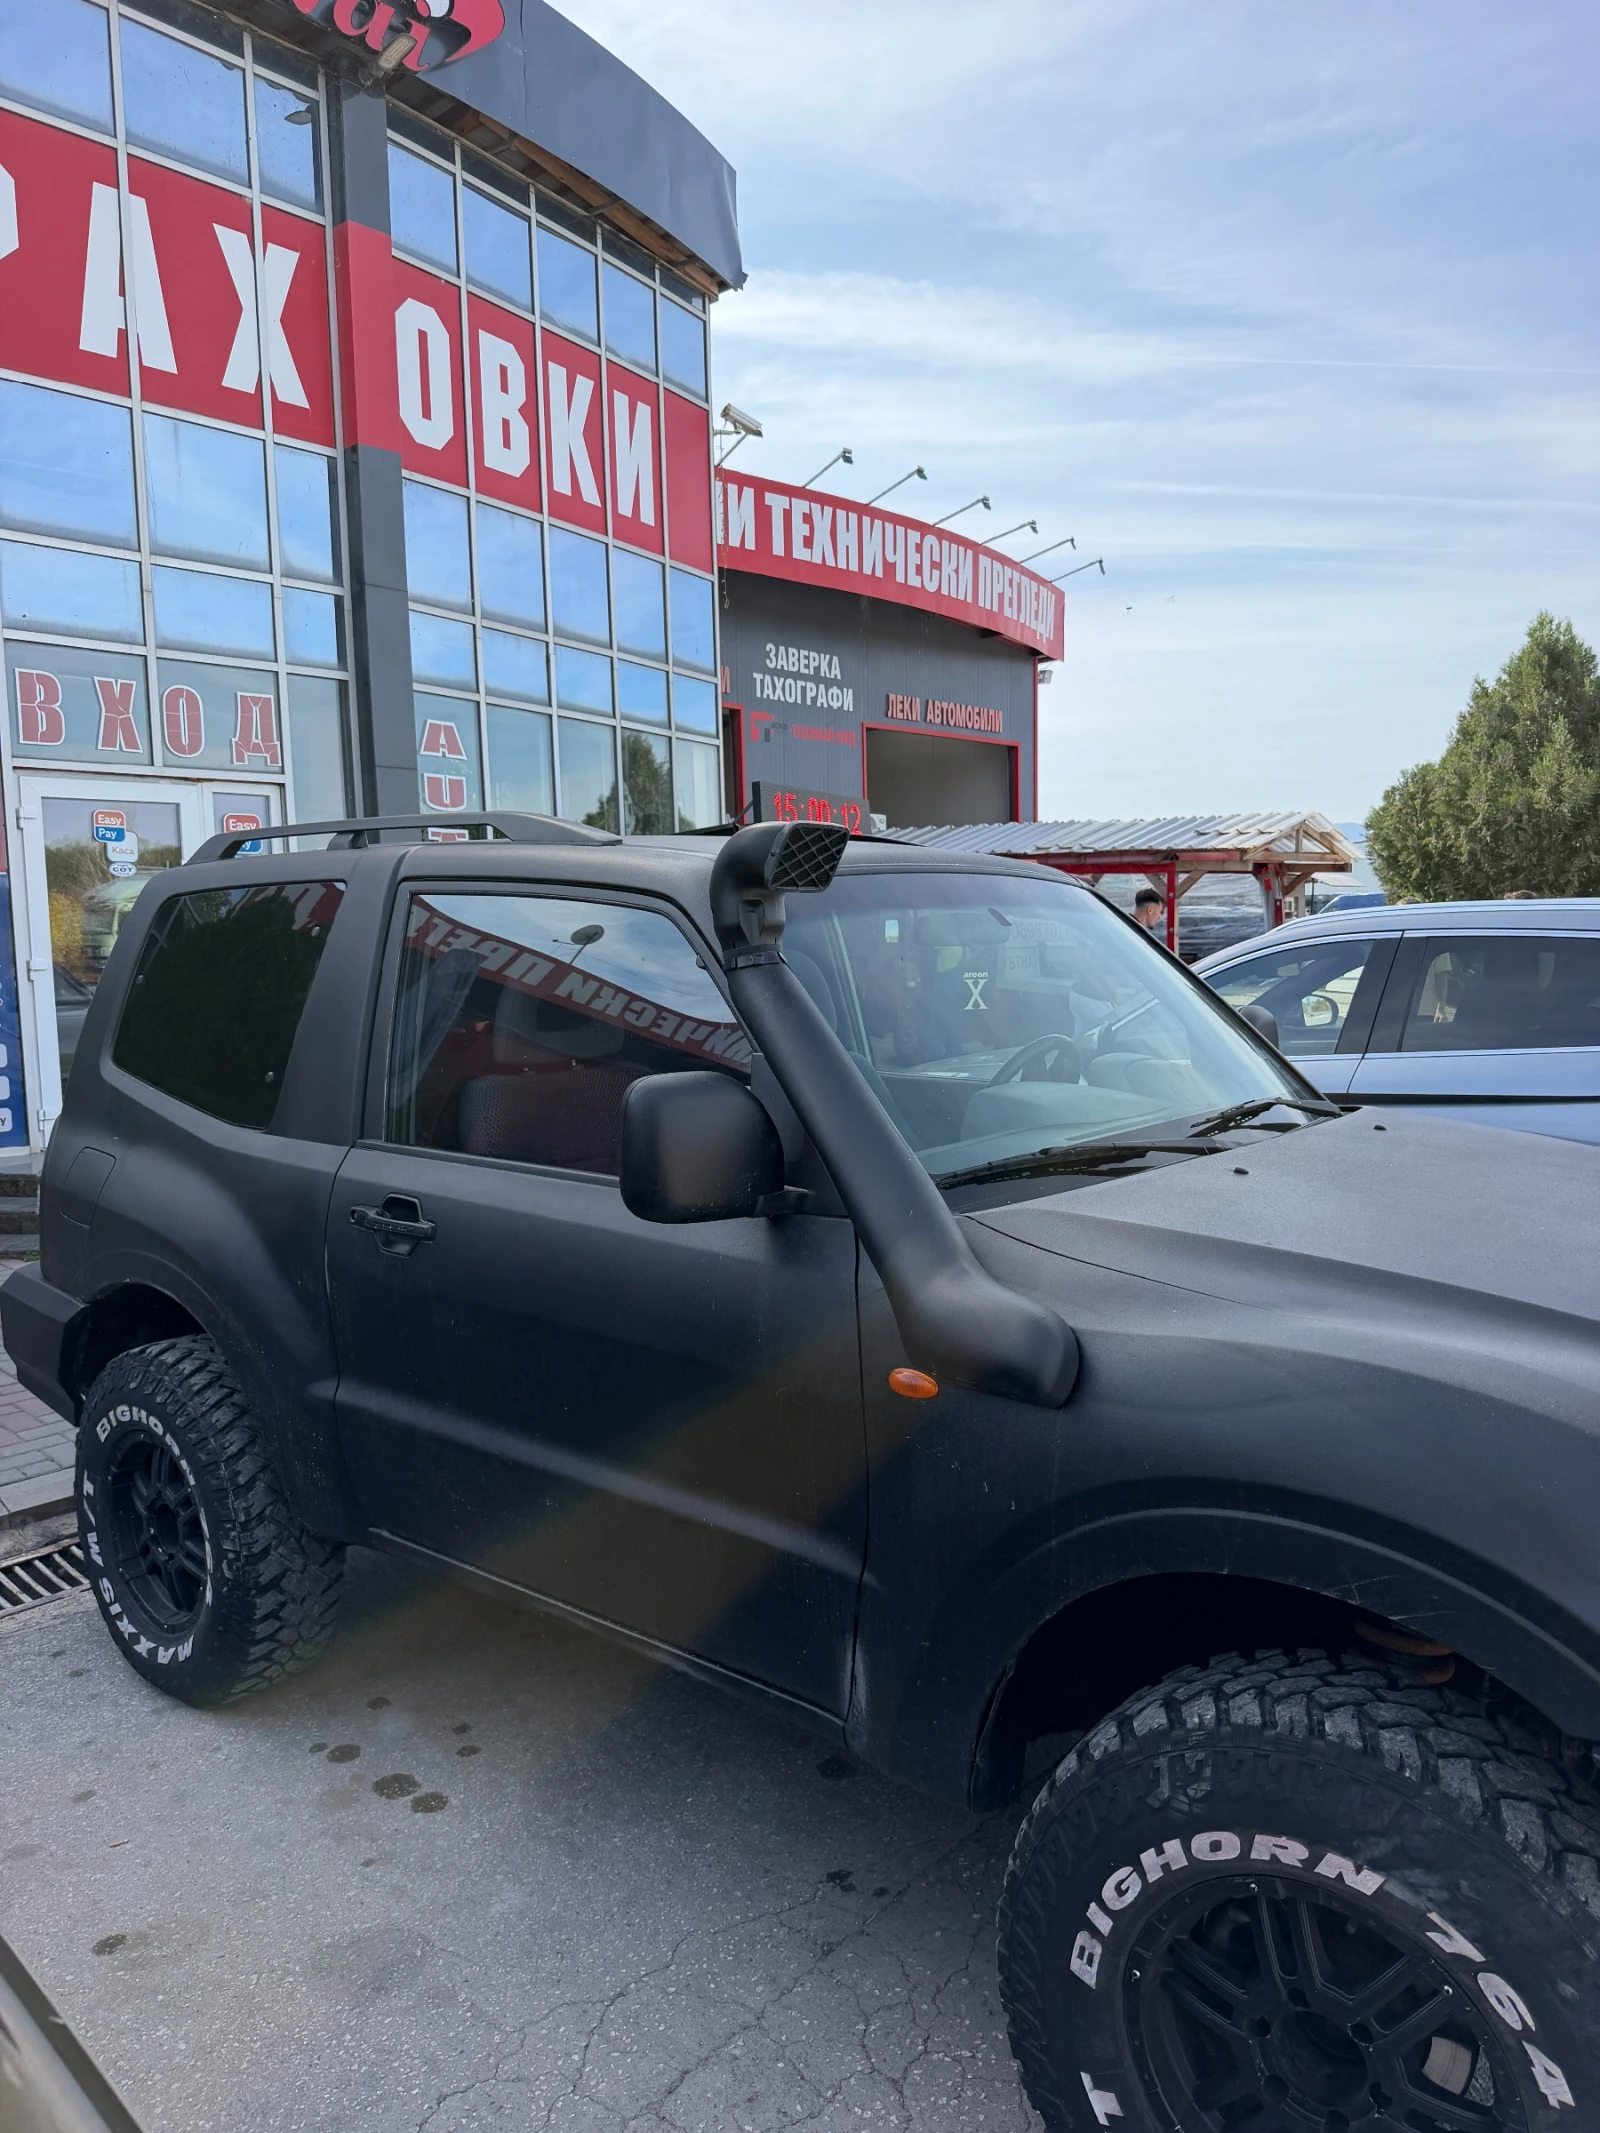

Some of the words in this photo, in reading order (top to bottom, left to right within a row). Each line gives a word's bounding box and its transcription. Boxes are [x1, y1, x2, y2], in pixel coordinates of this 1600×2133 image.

[764, 492, 972, 604] ТЕХНИЧЕСКИ
[978, 553, 1055, 641] ПРЕГЛЕДИ
[765, 642, 842, 680] ЗАВЕРКА
[753, 672, 854, 712] ТАХОГРАФИ
[14, 668, 282, 767] ВХОД
[887, 693, 920, 722] ЛЕКИ
[926, 698, 1003, 733] АВТОМОБИЛИ
[98, 814, 122, 826] Easy
[98, 828, 117, 841] Pay
[229, 818, 257, 831] Easy
[963, 971, 989, 979] areon
[964, 979, 989, 1010] X
[96, 1404, 196, 1486] BIGHORN
[99, 1576, 195, 1664] MAXXIS
[1069, 1831, 1385, 1989] BIGHORN
